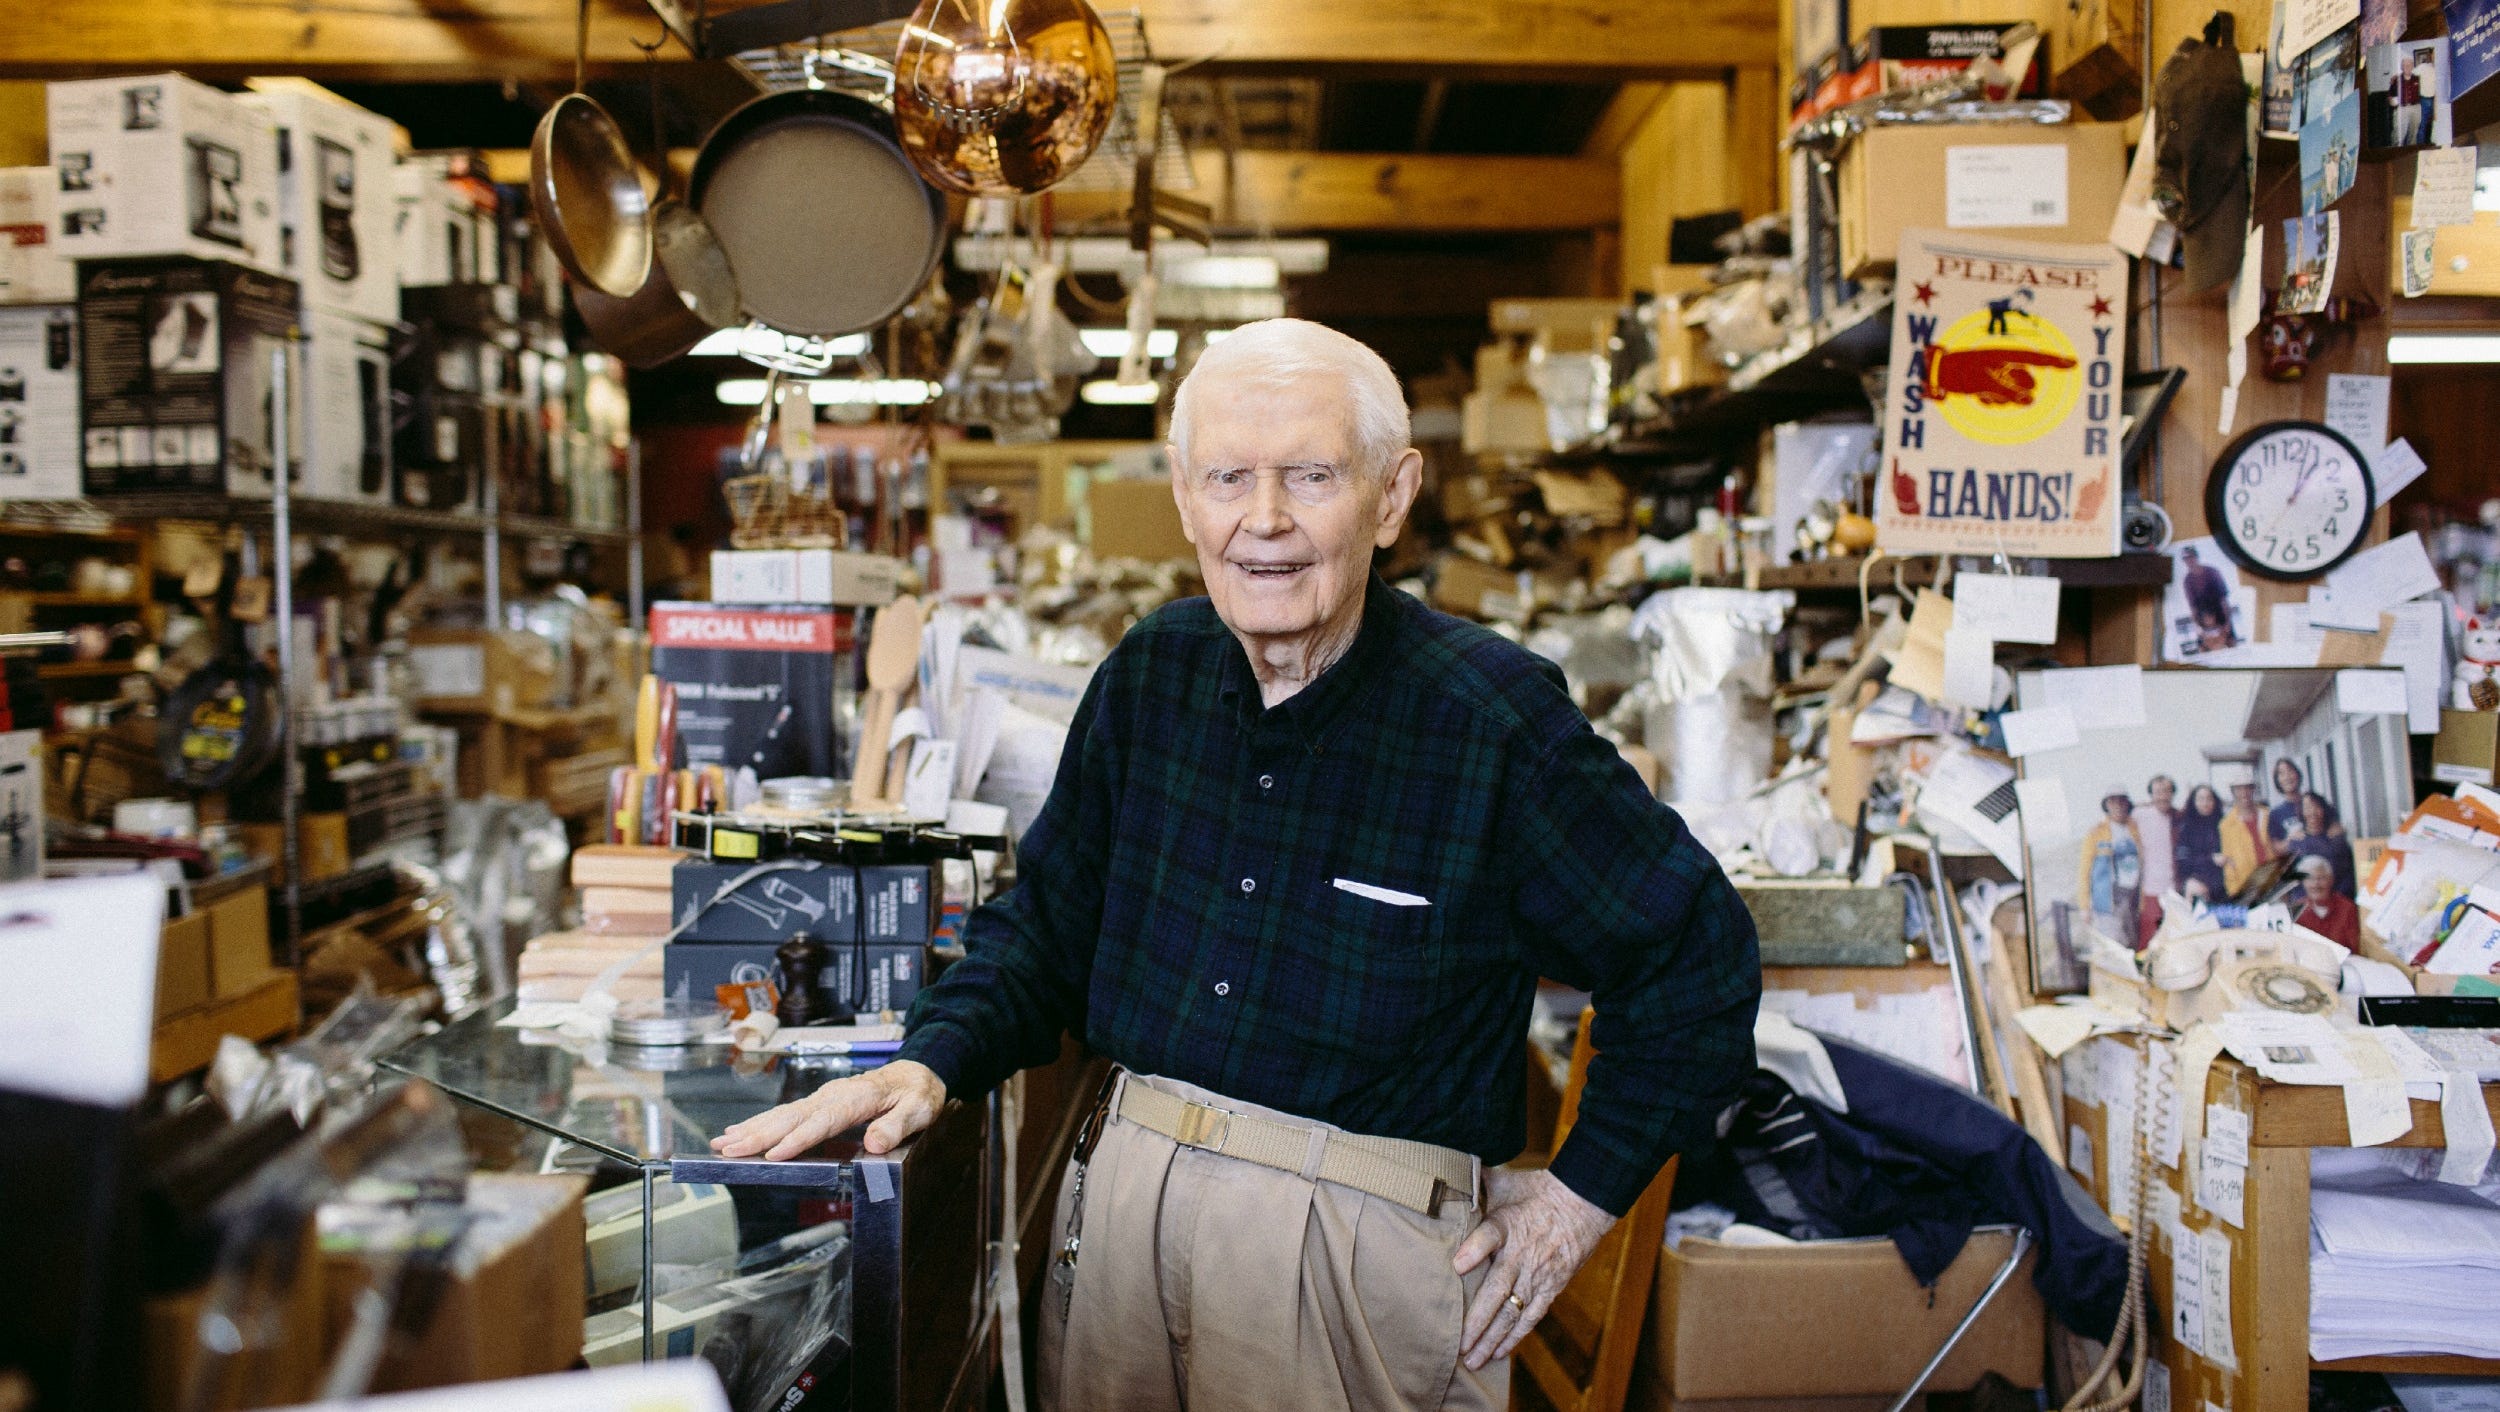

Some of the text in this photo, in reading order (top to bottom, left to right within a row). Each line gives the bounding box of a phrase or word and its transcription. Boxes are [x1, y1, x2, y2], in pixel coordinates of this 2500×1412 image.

[1927, 31, 1998, 47] ZWILLING
[1935, 254, 2099, 290] PLEASE
[1900, 314, 1937, 449] WASH
[2085, 327, 2112, 456] YOUR
[2262, 443, 2277, 467] 11
[2281, 438, 2304, 463] 12
[2240, 462, 2262, 487] 10
[2325, 458, 2341, 482] 2
[1927, 469, 2073, 522] HANDS!
[2232, 489, 2250, 513] 9
[2335, 488, 2349, 513] 3
[2242, 516, 2257, 540] 8
[2324, 517, 2337, 538] 4
[2263, 535, 2277, 559] 7
[2282, 542, 2299, 564] 6
[2306, 534, 2321, 560] 5
[667, 616, 816, 644] SPECIAL VALUE
